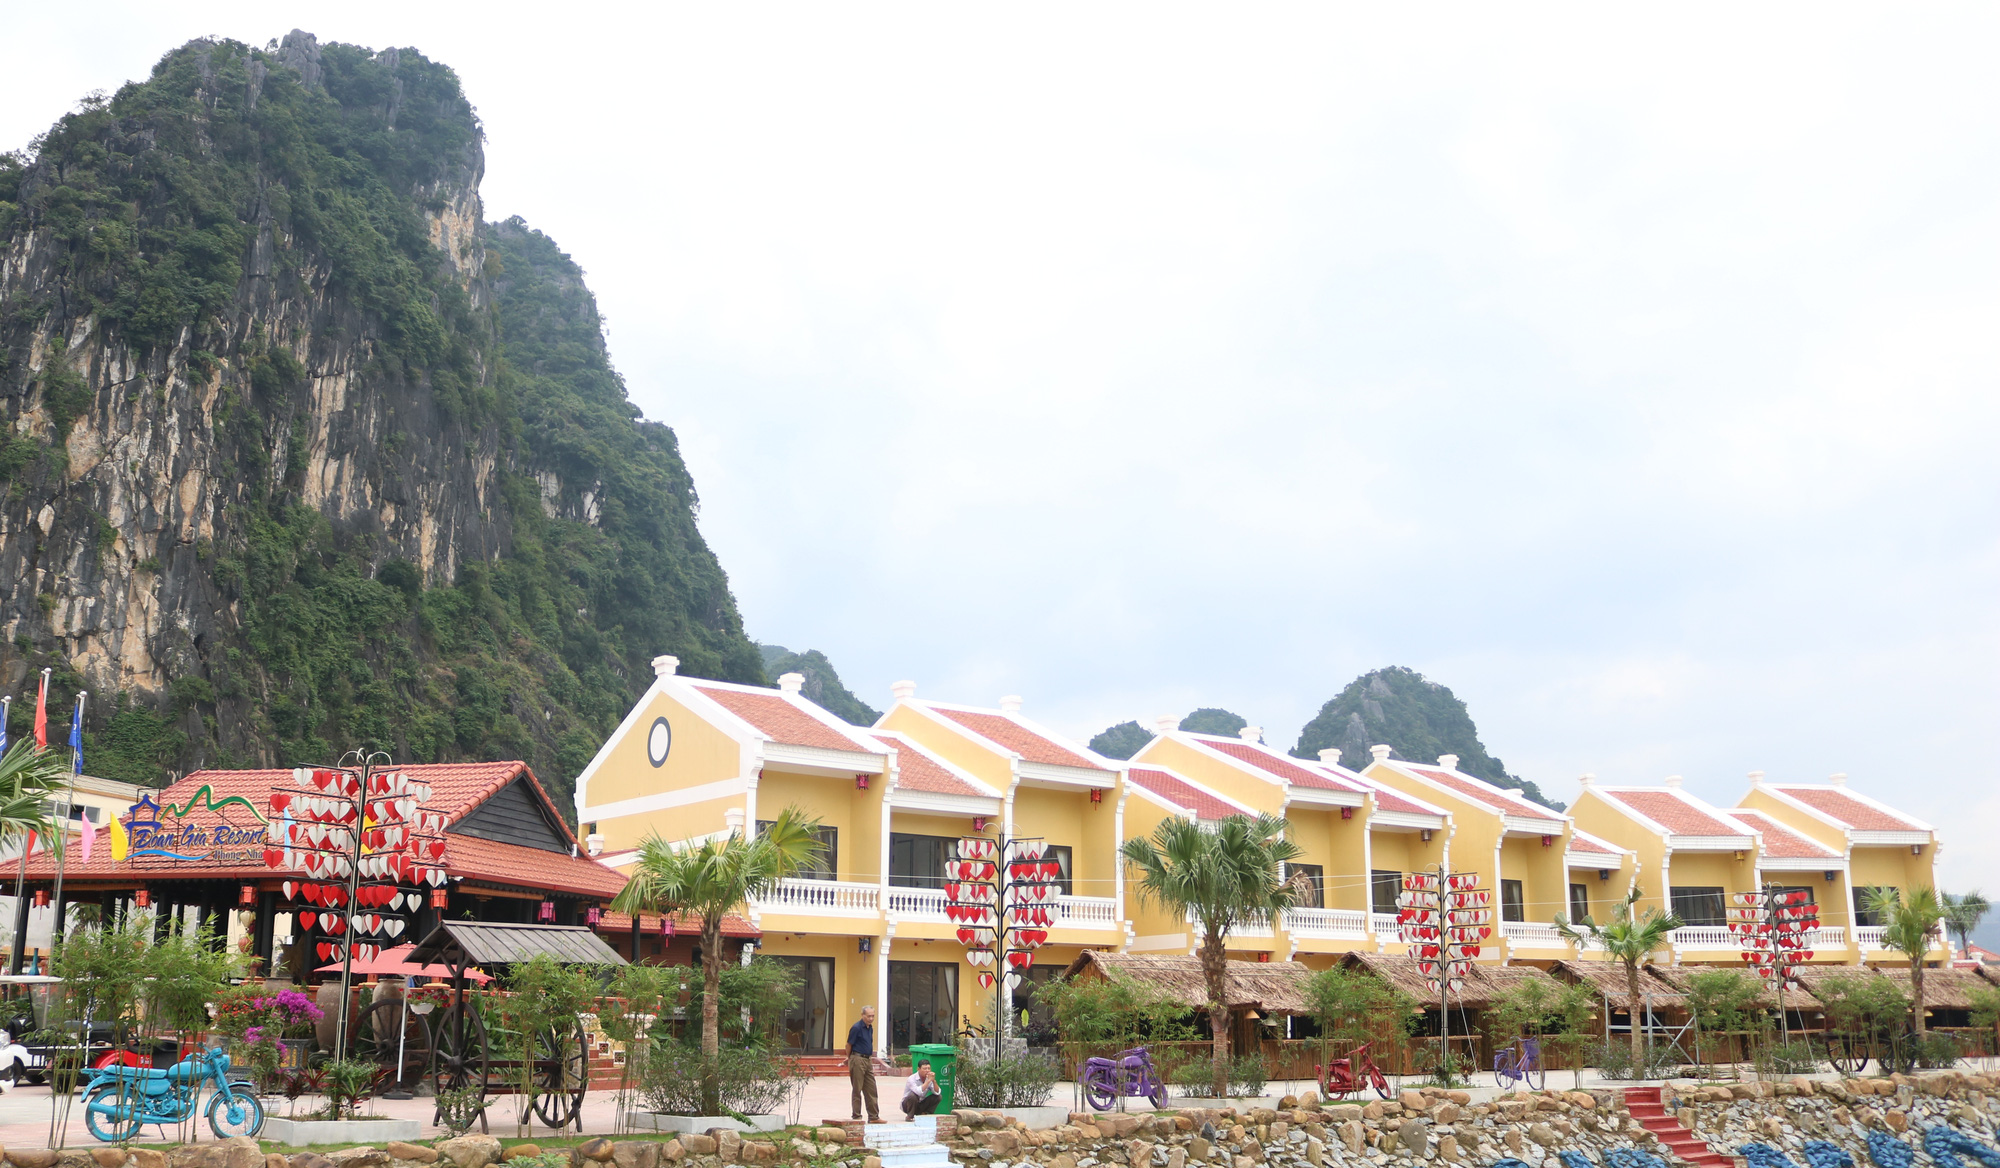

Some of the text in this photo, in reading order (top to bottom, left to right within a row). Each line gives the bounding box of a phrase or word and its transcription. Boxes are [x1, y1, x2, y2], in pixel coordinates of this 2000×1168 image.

[181, 824, 207, 848] Gia
[213, 825, 267, 845] Resort
[213, 848, 263, 861] Phong Nha
